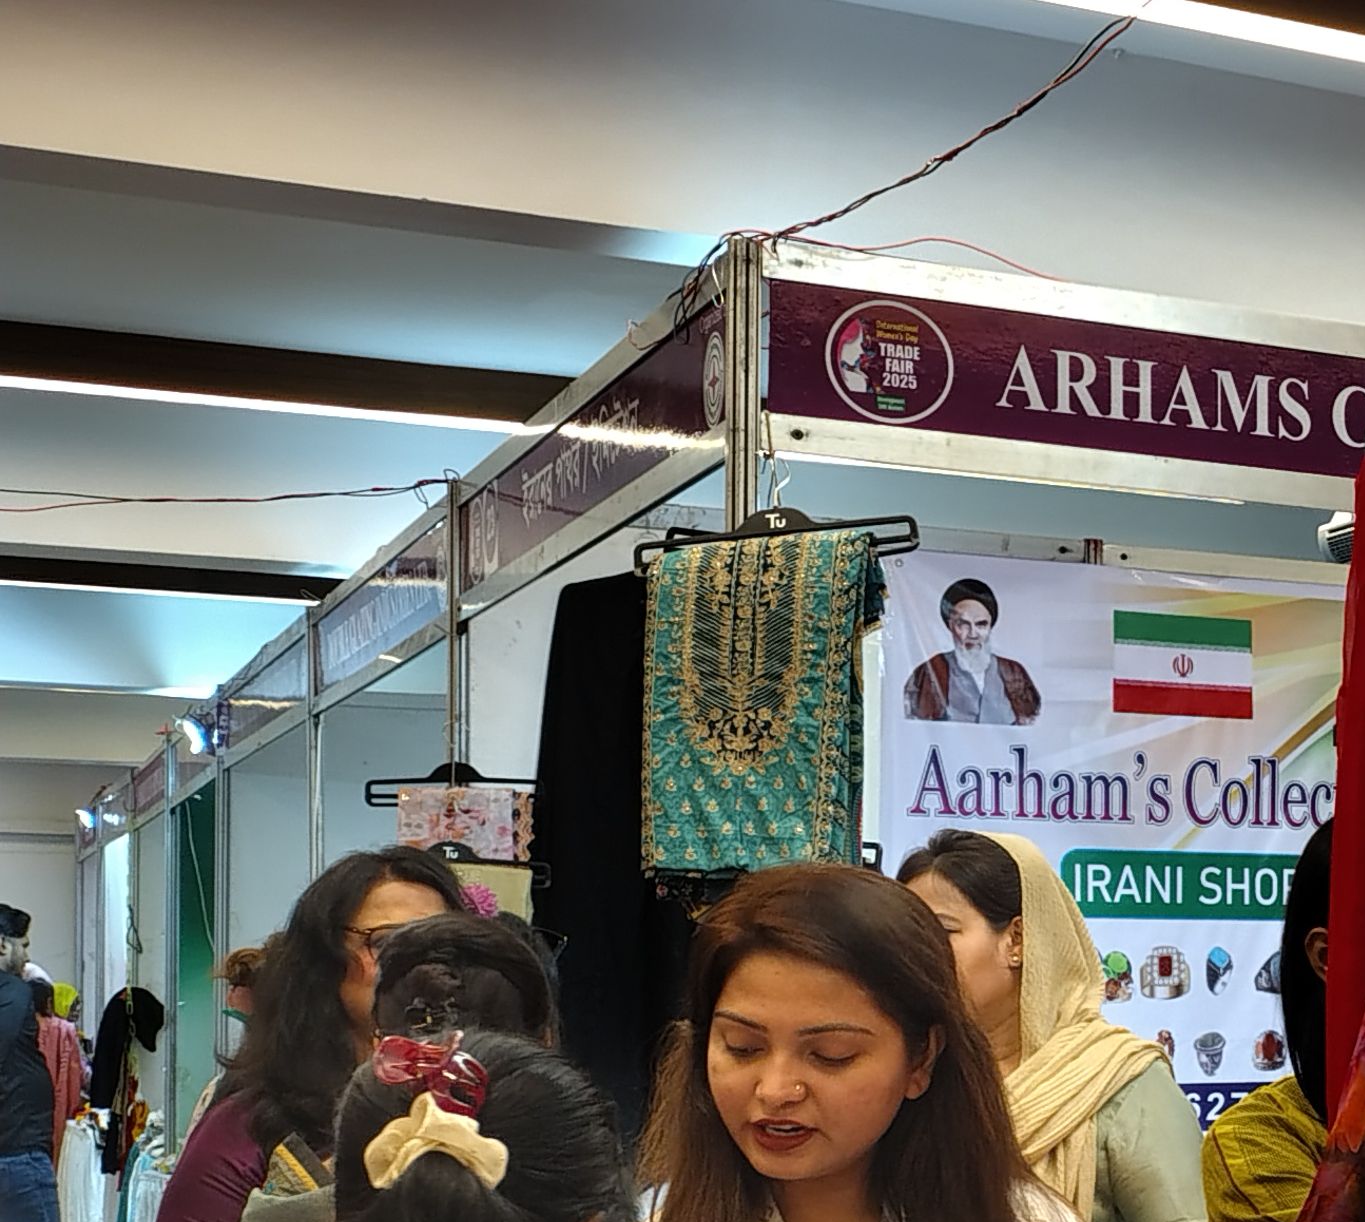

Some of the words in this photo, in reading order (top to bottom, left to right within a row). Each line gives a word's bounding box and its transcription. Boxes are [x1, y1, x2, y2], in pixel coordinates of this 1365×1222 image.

[879, 342, 920, 361] TRADE
[885, 358, 914, 375] FAIR
[882, 372, 918, 390] 2025
[995, 343, 1313, 442] ARHAMS
[764, 513, 787, 529] Tu
[906, 743, 1172, 826] Aarham's
[1184, 756, 1336, 830] Collec
[443, 846, 459, 860] Tu
[1073, 863, 1183, 906] IRANI
